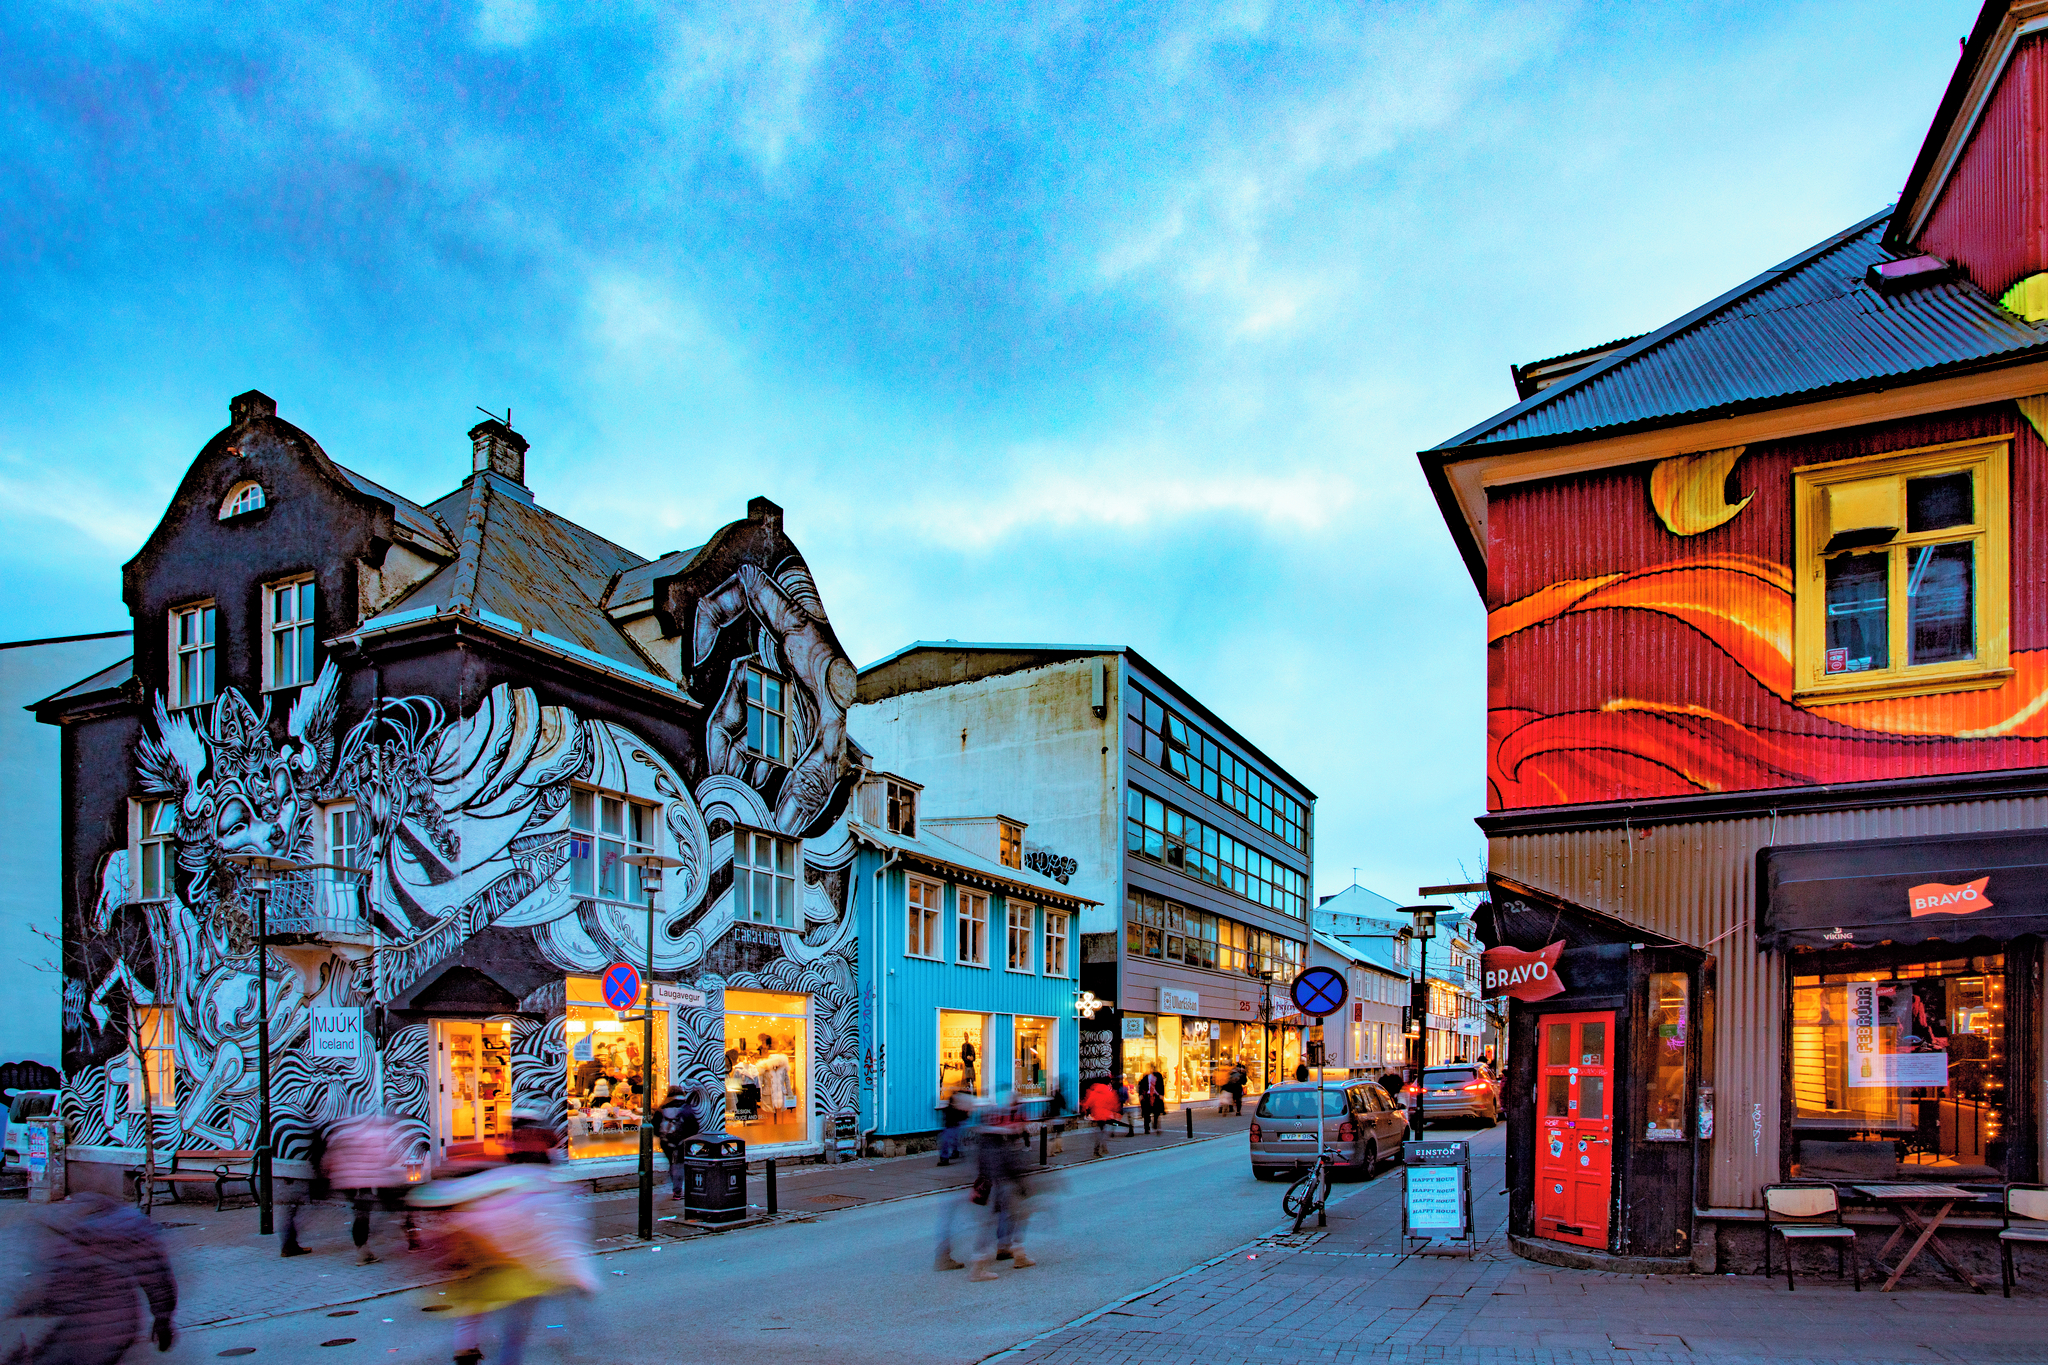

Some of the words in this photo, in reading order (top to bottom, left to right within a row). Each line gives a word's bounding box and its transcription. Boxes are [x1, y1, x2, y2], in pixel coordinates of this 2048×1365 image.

[1915, 885, 1977, 910] BRAVÓ
[1504, 900, 1531, 914] 22
[1823, 932, 1853, 940] VÍKING
[1486, 952, 1548, 989] BRAVÓ
[659, 987, 700, 1002] Laugavegur
[1240, 1001, 1250, 1011] 25
[315, 1012, 358, 1033] MJÚK
[319, 1038, 354, 1050] Iceland
